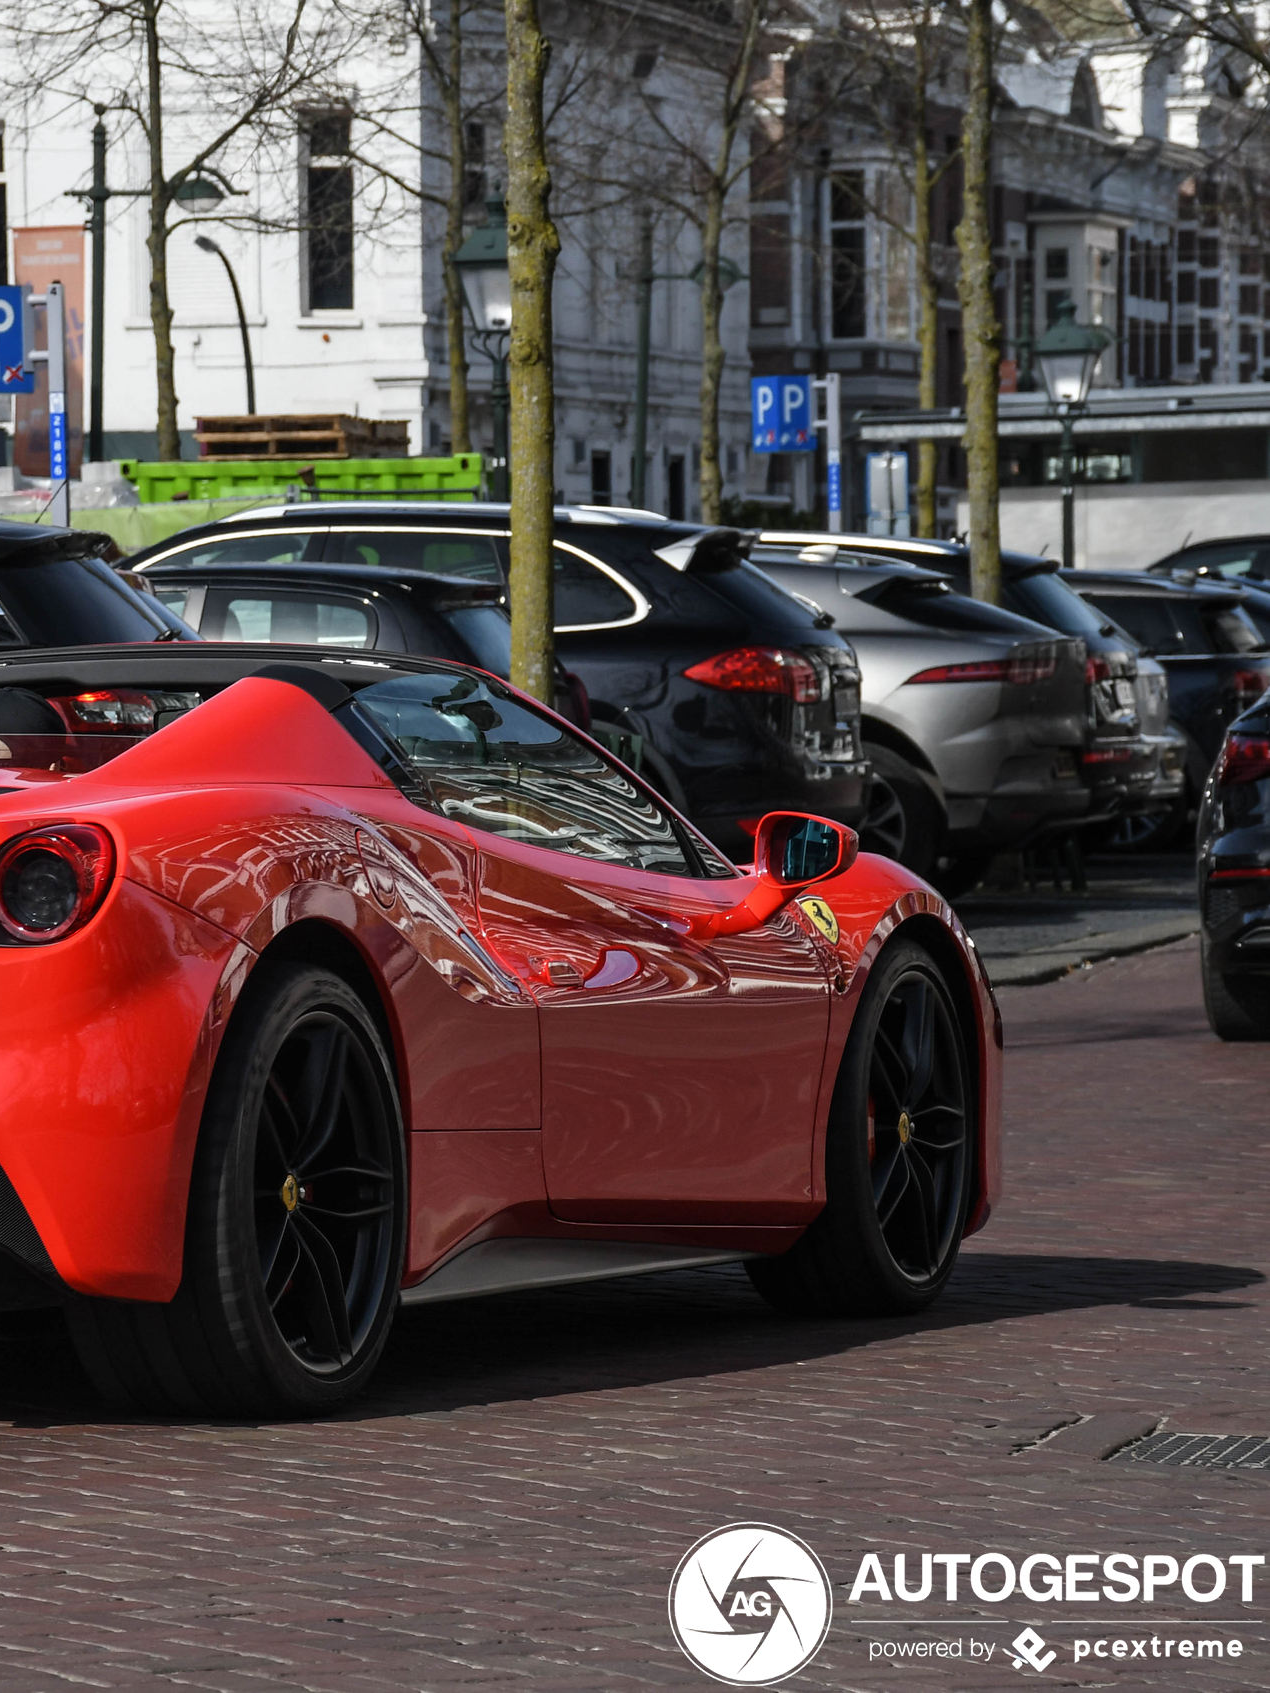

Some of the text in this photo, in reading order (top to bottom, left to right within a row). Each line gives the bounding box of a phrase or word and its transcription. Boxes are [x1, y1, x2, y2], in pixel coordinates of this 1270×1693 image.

[757, 386, 773, 426] P
[783, 384, 804, 424] P
[53, 416, 63, 476] 21846
